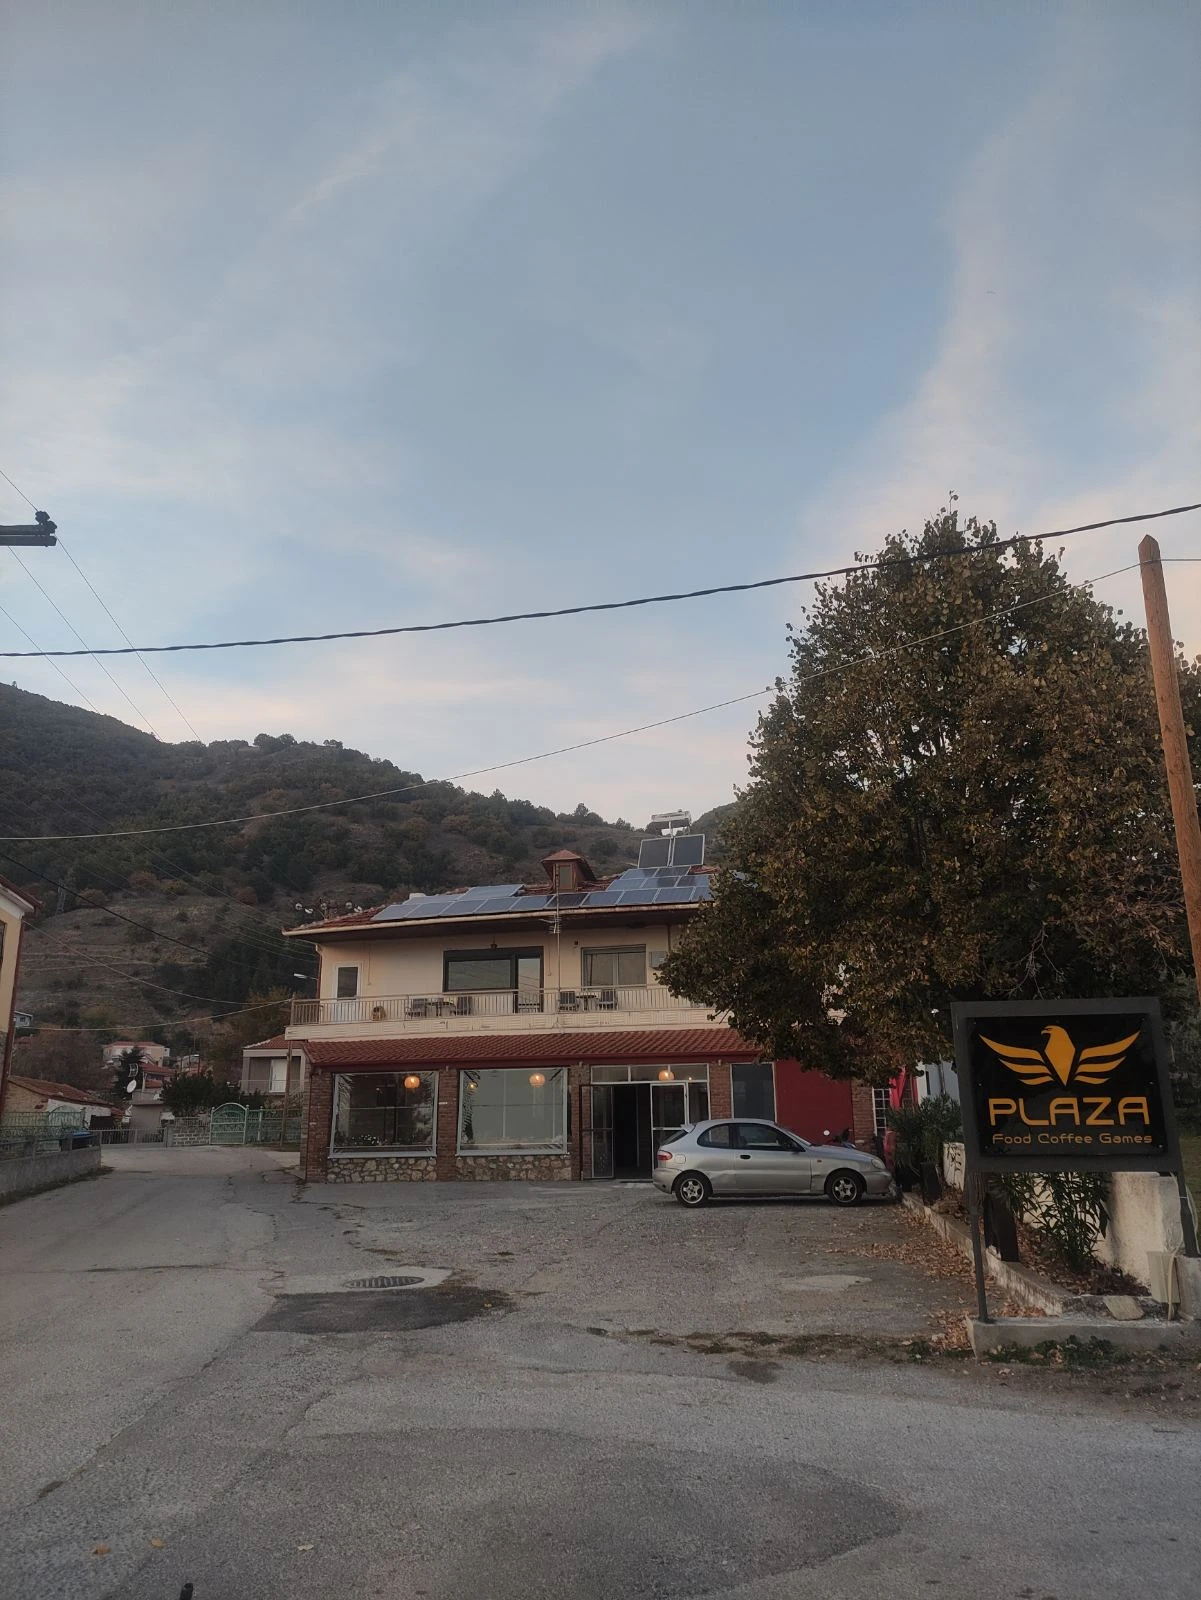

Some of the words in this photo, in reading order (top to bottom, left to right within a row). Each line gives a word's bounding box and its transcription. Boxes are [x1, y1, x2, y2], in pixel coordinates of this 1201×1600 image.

[988, 1096, 1150, 1126] PLAZA
[992, 1133, 1031, 1144] Food
[1037, 1133, 1093, 1144] Coffee
[1099, 1133, 1152, 1144] Games
